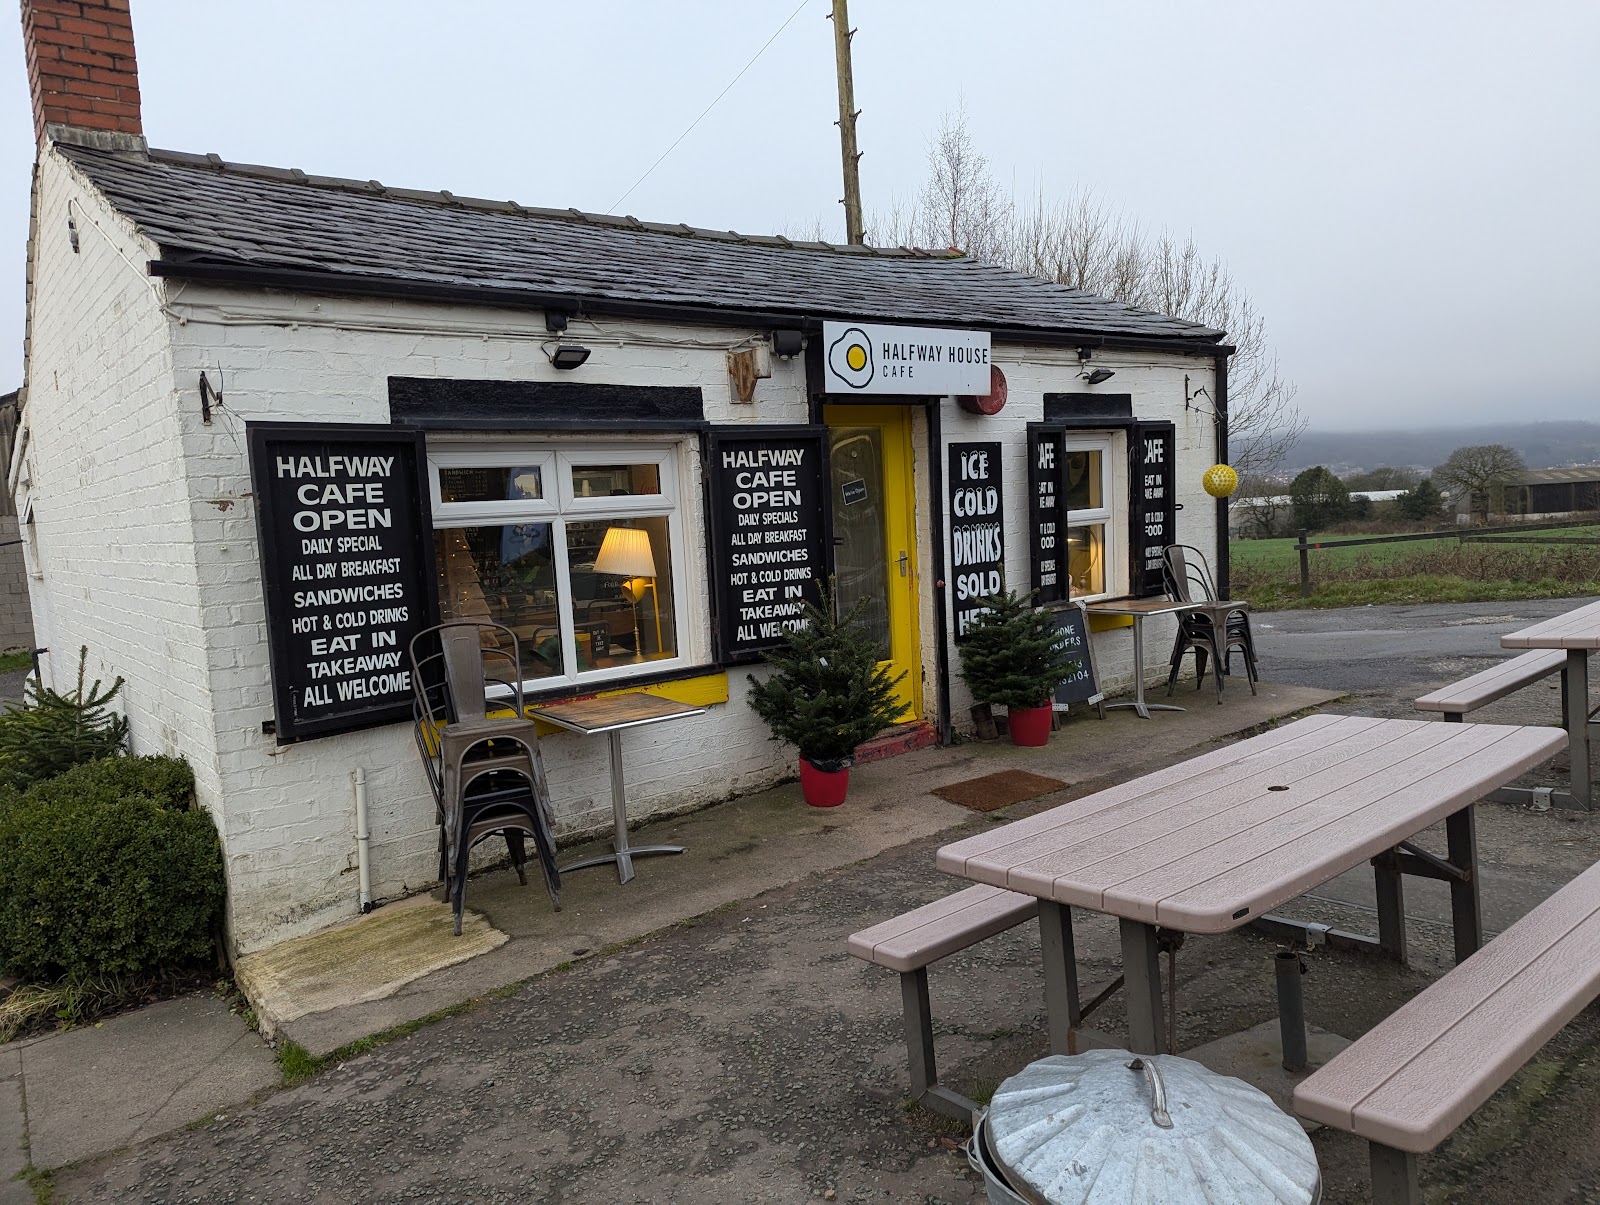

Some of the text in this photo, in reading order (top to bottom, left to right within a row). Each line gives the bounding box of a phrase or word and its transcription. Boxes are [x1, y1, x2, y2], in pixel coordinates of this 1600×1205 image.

[883, 342, 988, 364] HALFWAY HOUSE
[883, 365, 914, 378] CAFE
[276, 456, 394, 478] HALFWAY
[722, 449, 804, 469] HALFWAY
[961, 450, 989, 480] ICE
[736, 470, 796, 489] CAFE
[1156, 474, 1162, 485] IN
[297, 483, 384, 506] CAFE
[732, 490, 801, 509] OPEN
[954, 485, 998, 518] COLD
[293, 508, 391, 532] OPEN
[738, 510, 798, 527] DAILY SPECIALS
[301, 535, 382, 555] DAILY SPECIAL
[731, 528, 807, 546] ALL DAY BREAKFAST
[953, 522, 1001, 567] DRINKS
[1041, 536, 1055, 549] OOD
[732, 548, 808, 567] SANDWICHES
[292, 557, 400, 581] ALL DAY BREAKFAST
[730, 567, 812, 586] HOT & COLD DRINKS
[293, 583, 403, 608] SANDWICHES
[743, 585, 803, 603] EAT IN
[957, 570, 1000, 601] SOLD
[292, 606, 409, 634] HOT & COLD DRINKS
[311, 630, 396, 656] EAT IN
[737, 625, 757, 642] ALL
[307, 651, 403, 679] TAKEAWAY
[303, 682, 332, 708] ALL
[336, 671, 411, 702] WELCOME
